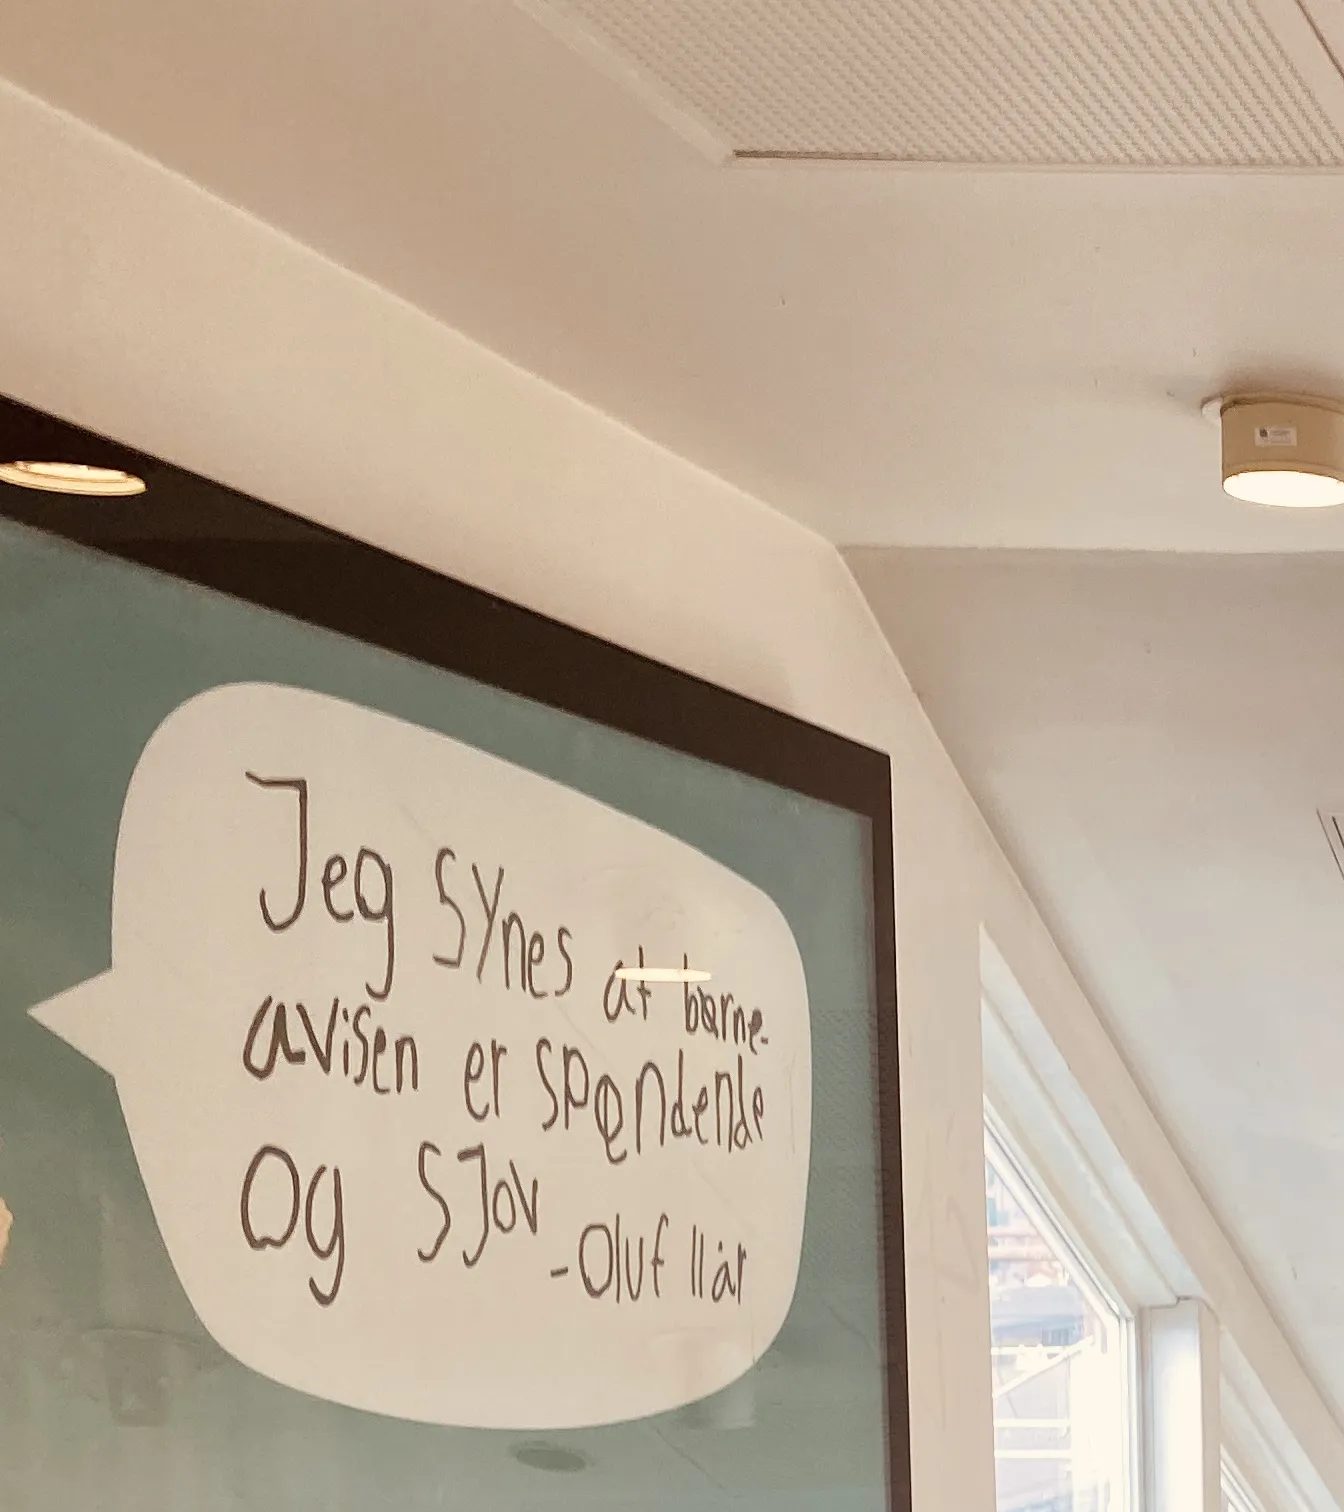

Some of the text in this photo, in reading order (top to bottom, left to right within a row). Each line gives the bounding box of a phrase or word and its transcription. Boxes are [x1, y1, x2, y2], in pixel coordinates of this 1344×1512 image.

[245, 771, 395, 1000] Jeg
[603, 945, 653, 1022] at
[242, 994, 419, 1095] avisen
[464, 1038, 508, 1121] er
